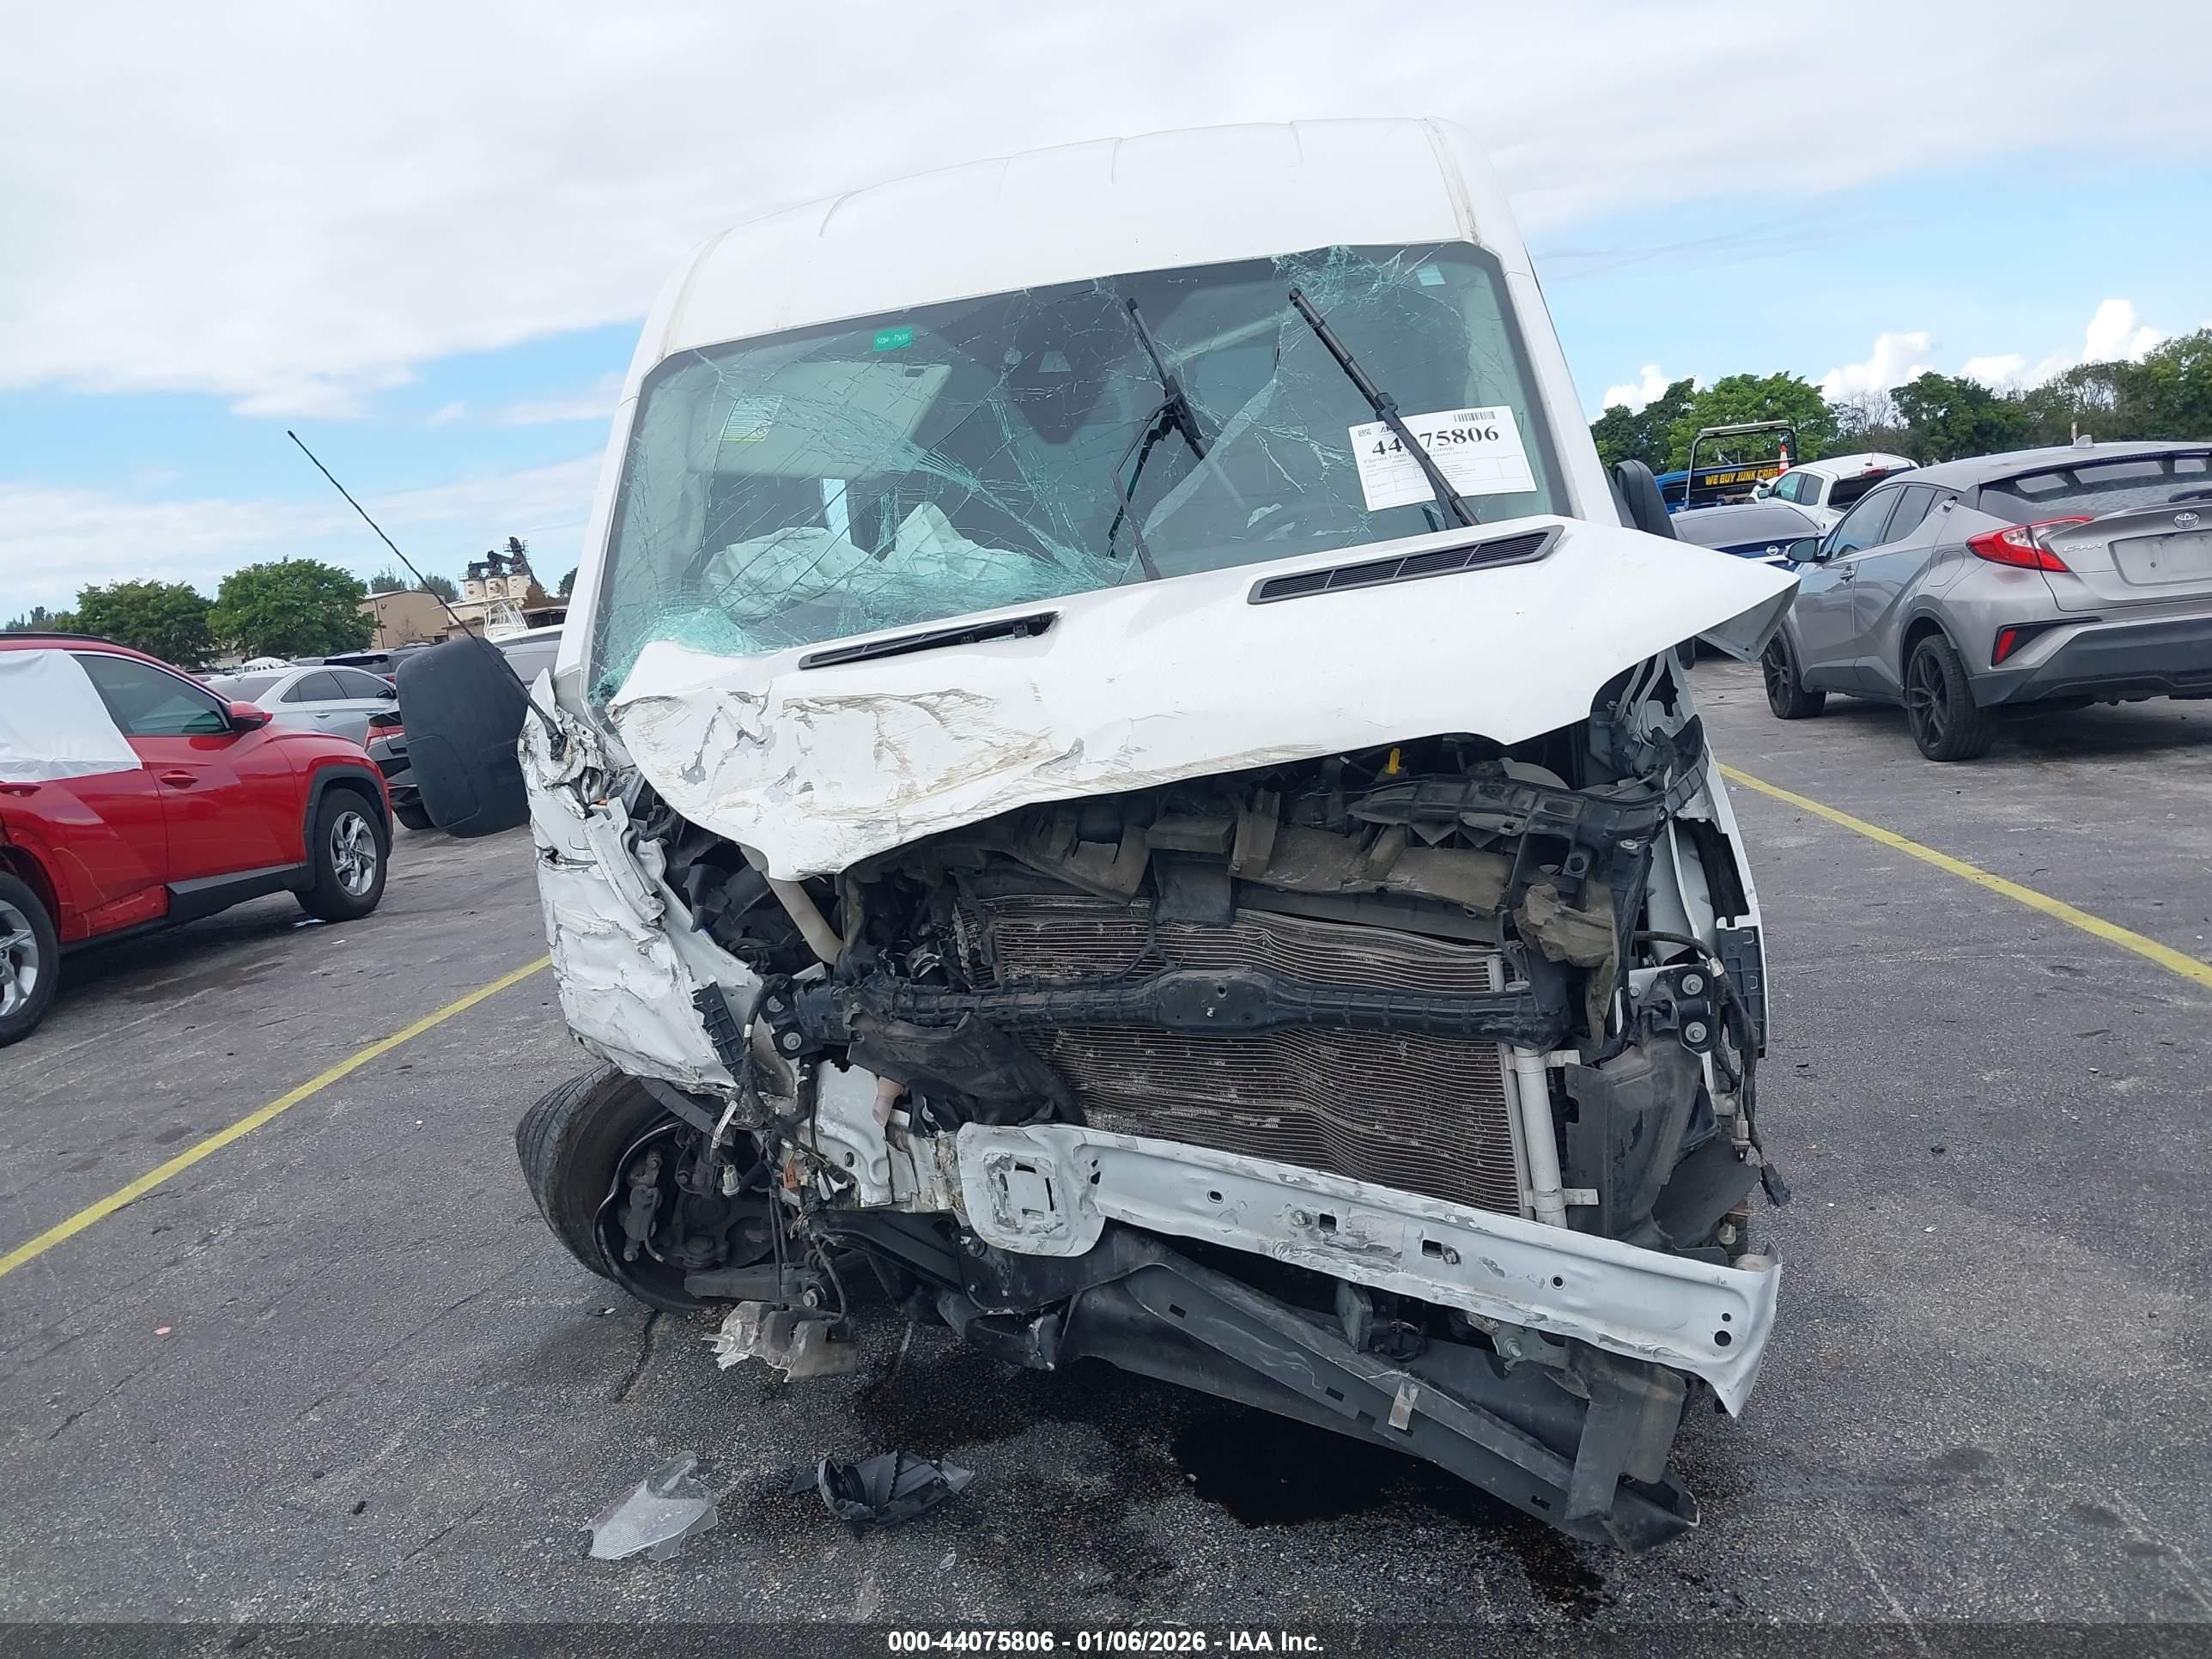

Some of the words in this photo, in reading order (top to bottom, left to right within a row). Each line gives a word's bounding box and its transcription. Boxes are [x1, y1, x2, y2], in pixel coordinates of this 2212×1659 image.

[1371, 425, 1499, 456] 4475806
[1705, 475, 1718, 485] WE
[1719, 472, 1736, 484] BUY
[1737, 471, 1757, 482] JUNK
[1757, 468, 1779, 479] CARS
[2063, 543, 2103, 552] C-HR
